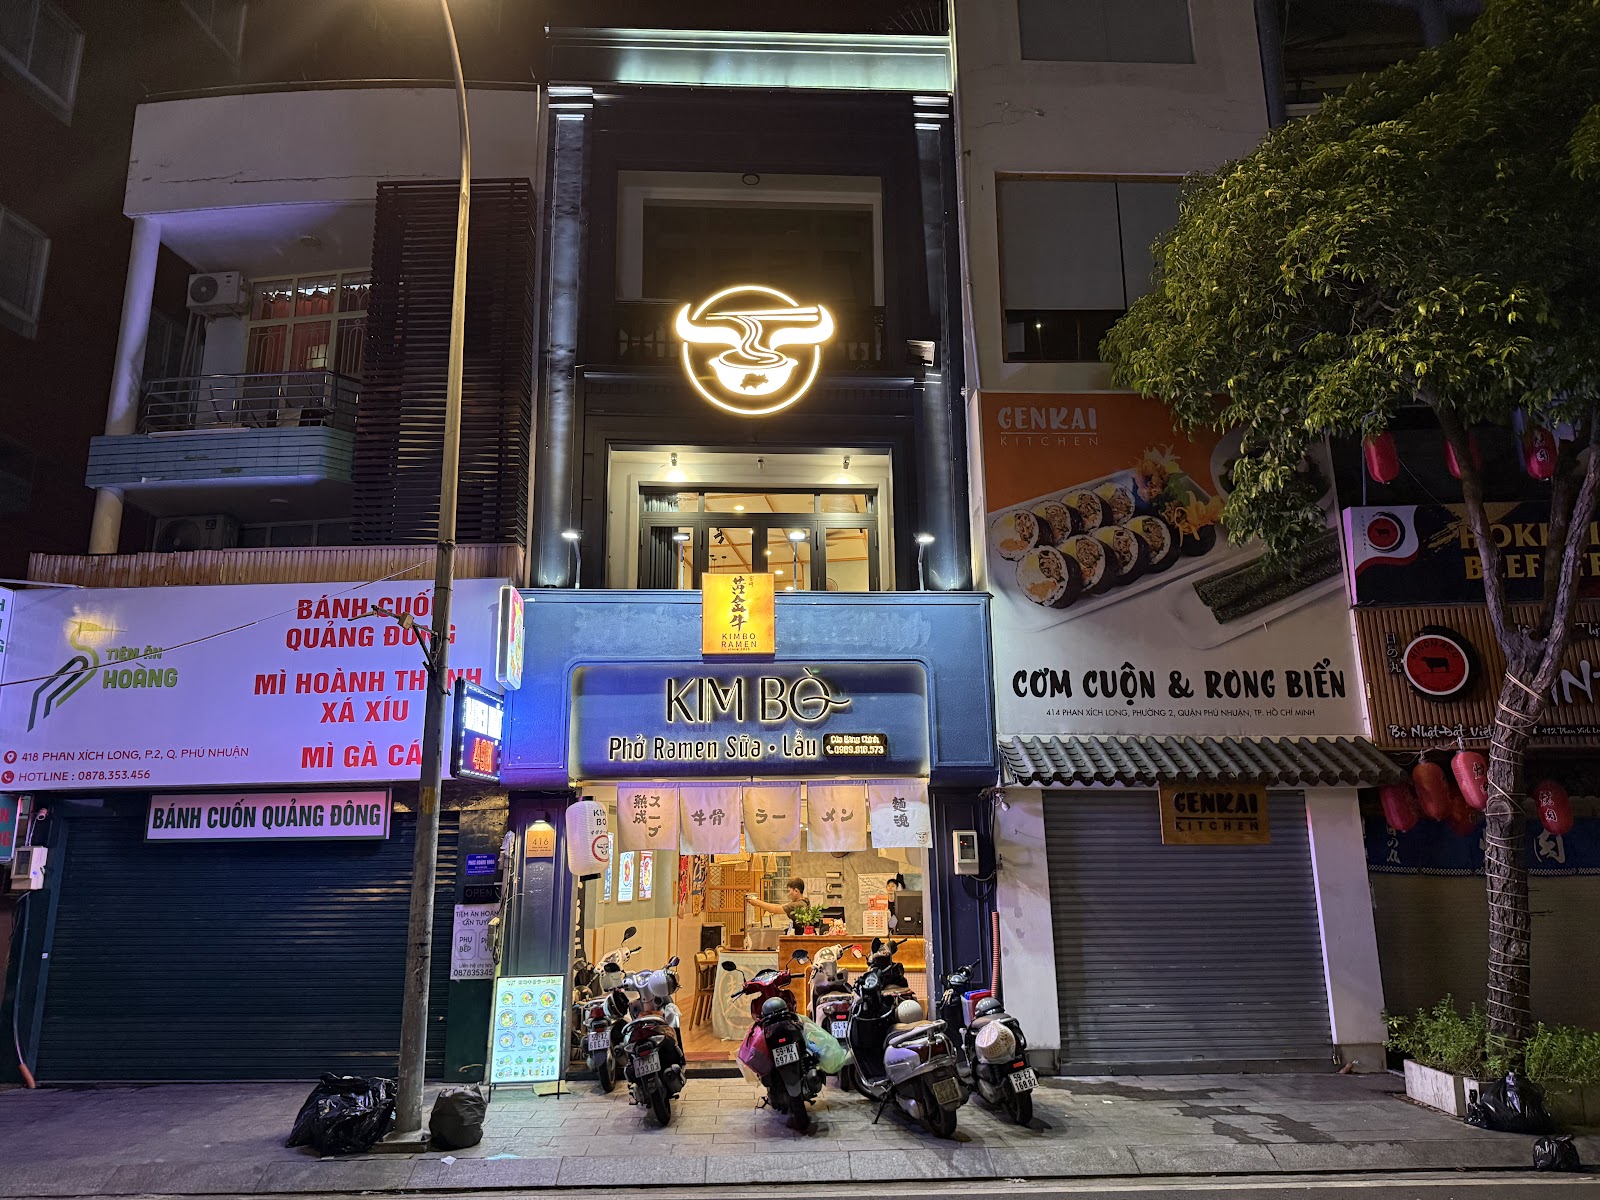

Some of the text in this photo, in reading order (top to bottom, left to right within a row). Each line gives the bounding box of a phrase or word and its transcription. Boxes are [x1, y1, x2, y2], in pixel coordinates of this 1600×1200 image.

[998, 407, 1097, 430] GENKAI
[1000, 437, 1098, 446] KITCHEN
[1464, 553, 1541, 580] BEF
[297, 589, 433, 620] BÁNH CUỐ
[286, 620, 374, 651] QUẢNG
[1386, 632, 1402, 673] 日の丸
[102, 662, 178, 689] HOÀNG
[254, 668, 482, 695] MÌ HOÀNH THNH
[1012, 657, 1346, 706] CƠM CUỘN & RONG BIỂN
[666, 666, 851, 723] KIM BÒ
[320, 696, 409, 723] XÁ XÍU
[1046, 707, 1315, 718] 414 PHAN XÍCH LONG, PHƯỜNG 2, QUẬN PHÚ NHUẬN, TP. HỒ CHÍ MINH
[1389, 724, 1408, 738] Bò
[1542, 727, 1557, 735] 412
[21, 746, 249, 762] 418 PHAN XÍCH LONG, P.2, Q. PHÚ NHUẬN
[301, 742, 334, 768] MÌ
[343, 741, 378, 768] GÀ
[609, 728, 816, 760] Phở Ramen Sữa Lẩu
[18, 771, 69, 782] HOTLINE
[78, 769, 151, 780] 0878.353.456
[152, 798, 381, 830] BÁNH CUỐN QUẢNG ĐÔNG
[1174, 792, 1258, 814] GENKAI
[648, 795, 662, 838] スープ
[691, 808, 726, 826] 牛骨
[755, 808, 786, 824] ラー
[821, 807, 854, 823] メン
[1175, 821, 1259, 833] KITCHEN
[532, 837, 549, 846] 416
[465, 888, 493, 898] OPEN
